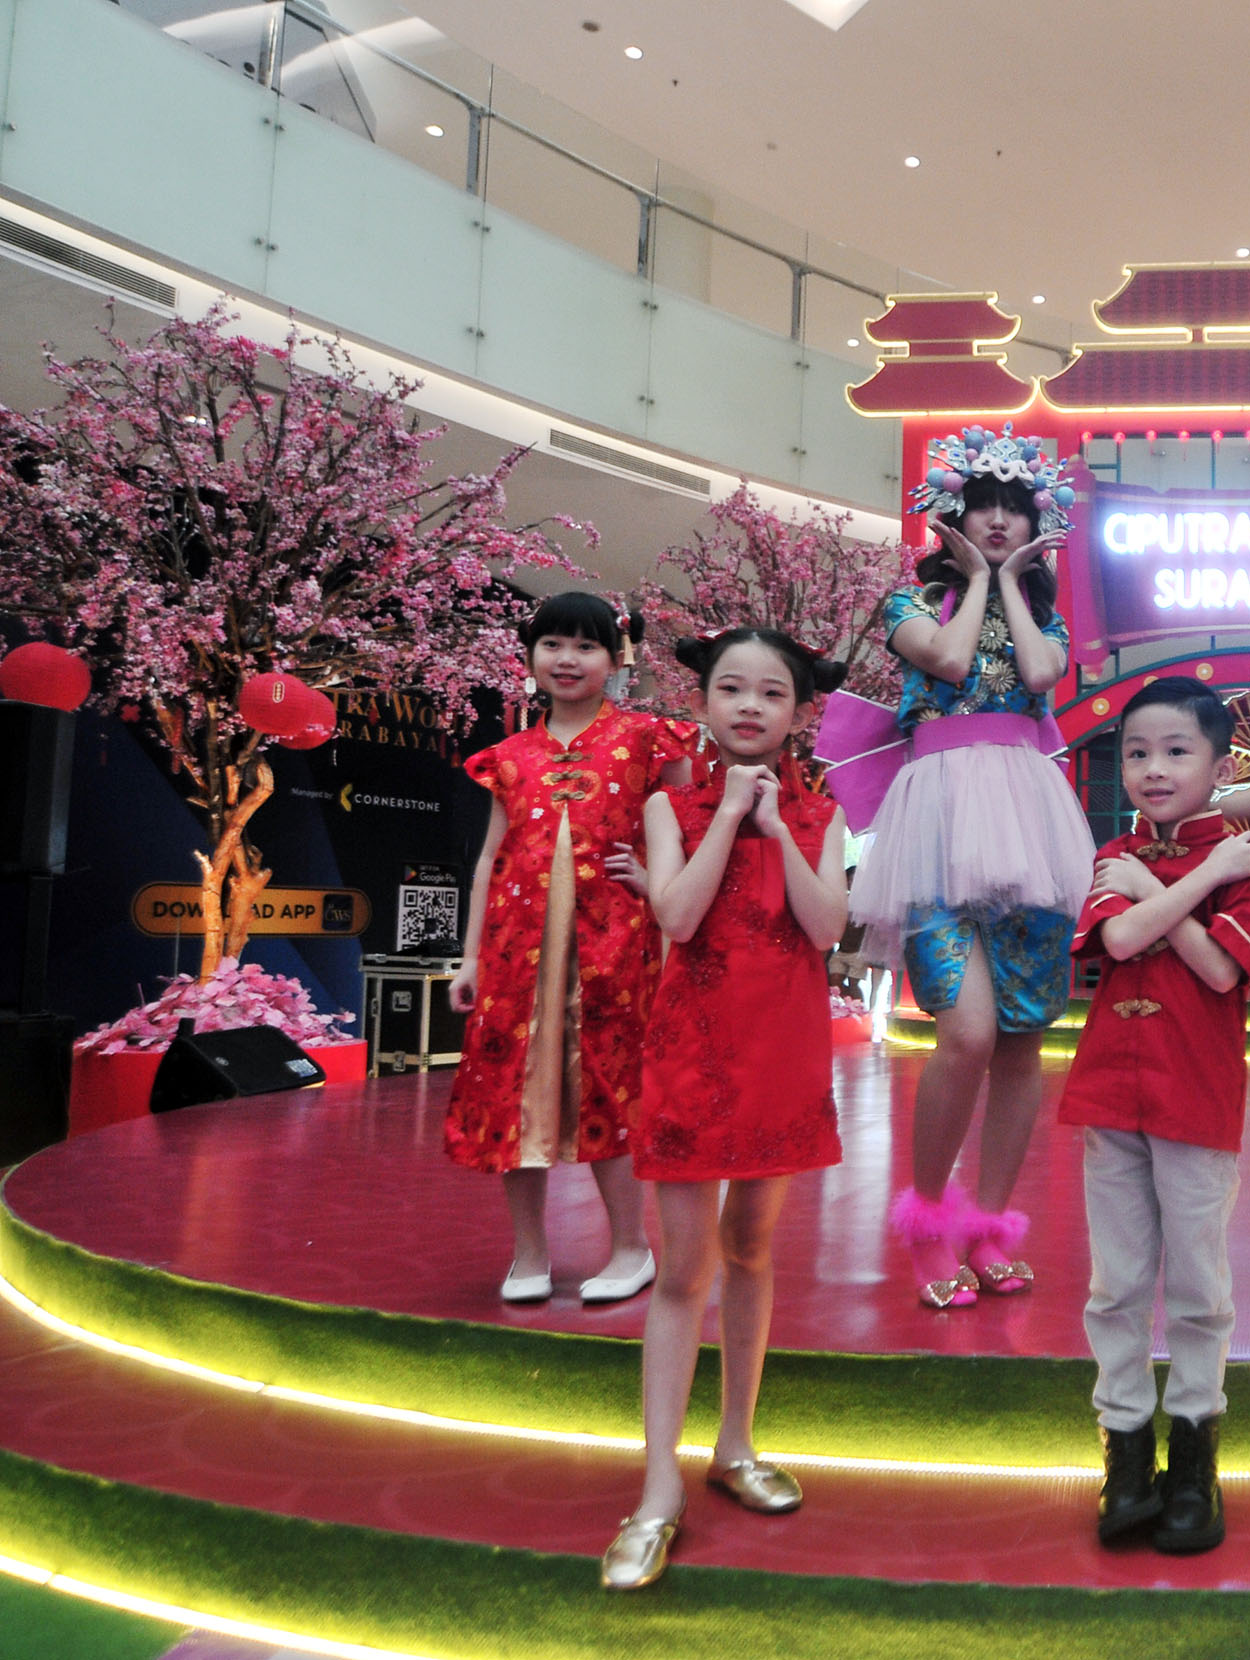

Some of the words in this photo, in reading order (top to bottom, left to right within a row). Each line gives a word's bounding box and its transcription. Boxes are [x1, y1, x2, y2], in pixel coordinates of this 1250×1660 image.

[339, 719, 438, 752] RABAYA
[353, 793, 441, 812] CORNERSTONE
[280, 904, 316, 919] APP
